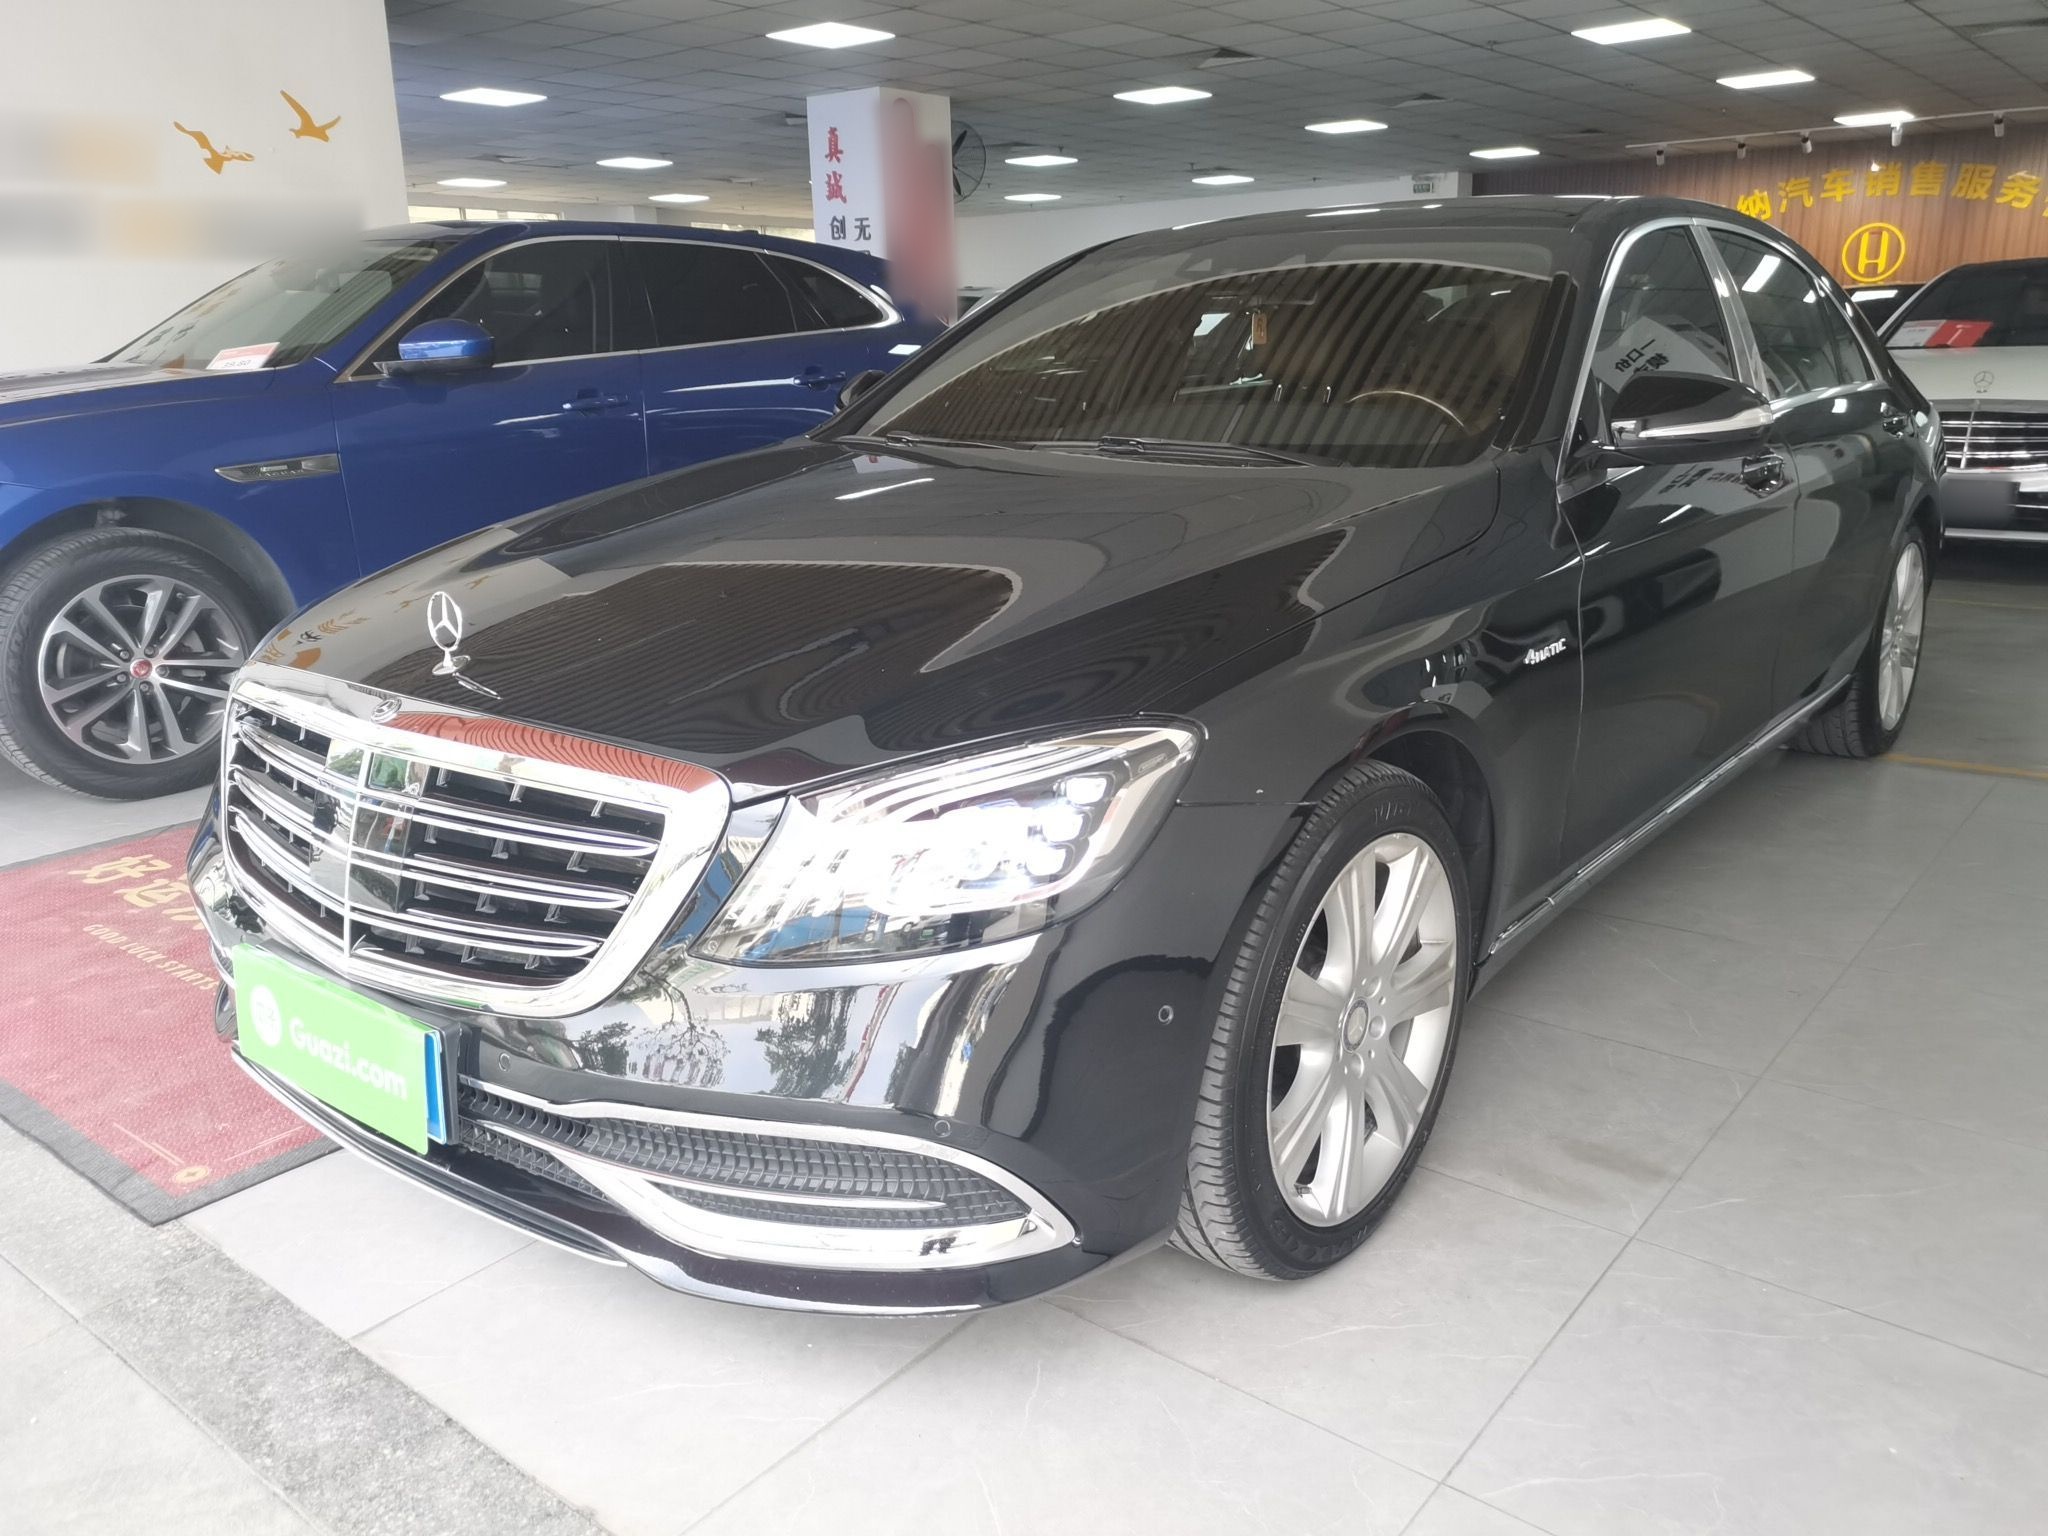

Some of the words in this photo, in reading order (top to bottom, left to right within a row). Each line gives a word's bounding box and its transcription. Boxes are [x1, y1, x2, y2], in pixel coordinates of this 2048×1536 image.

[1736, 161, 2048, 221] 纳汽车销售服务
[83, 924, 128, 944] GOOD
[119, 942, 168, 963] LUCK
[156, 960, 219, 990] STARTS
[288, 1016, 408, 1101] Guazi.com
